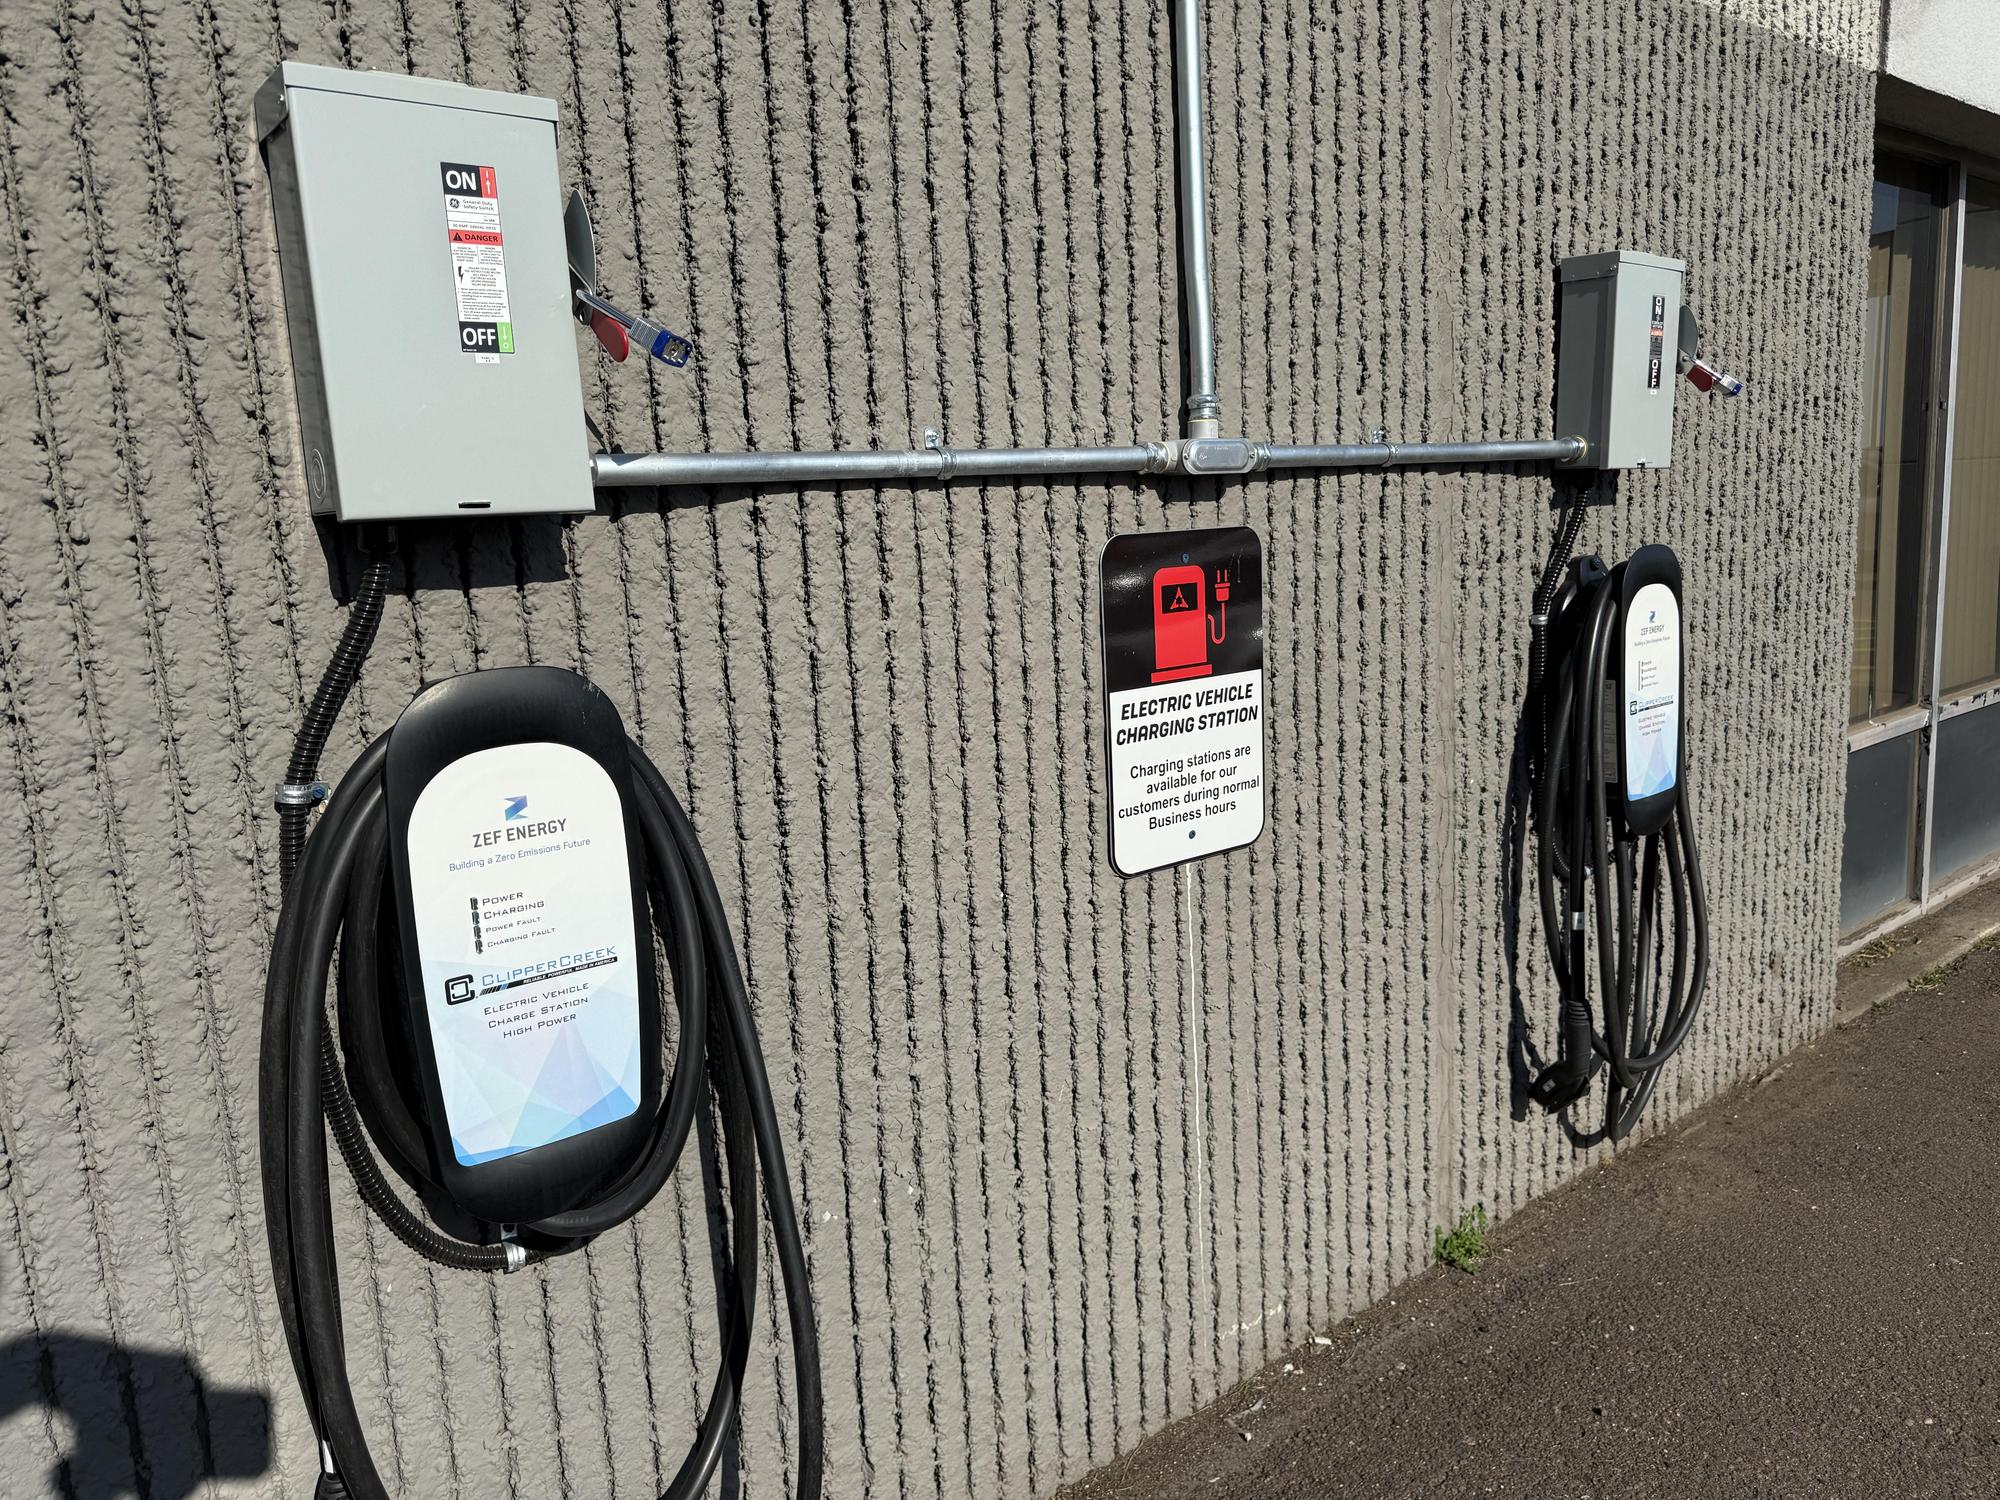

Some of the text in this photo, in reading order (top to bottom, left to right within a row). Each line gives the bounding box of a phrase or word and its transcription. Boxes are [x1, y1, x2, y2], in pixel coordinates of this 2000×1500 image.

[446, 170, 476, 190] ON
[465, 234, 498, 242] DANGER
[1655, 297, 1662, 315] ON
[462, 328, 496, 346] OFF
[1121, 684, 1253, 720] ELECTRIC VEHICLE
[1116, 705, 1258, 746] CHARGING STATION
[1130, 745, 1251, 780] Charging stations are
[1146, 765, 1238, 794] available for our
[1118, 775, 1259, 818] customers during normal
[1148, 800, 1236, 830] Business hours
[472, 818, 567, 848] ZEF ENERGY
[449, 857, 485, 872] Building
[495, 852, 516, 863] Zero
[518, 843, 561, 858] Emissions
[563, 838, 591, 849] Future
[482, 892, 524, 906] POWER
[484, 900, 545, 920] CHARGING
[486, 916, 542, 933] POWER FAULT
[487, 928, 556, 948] CHARGING FAULT
[482, 946, 616, 986] CLIPPERCREEK
[484, 982, 589, 1015] ELECTRIC VEHICLE
[488, 997, 589, 1029] CHARGE STATION
[503, 1013, 577, 1039] HIGH POWER
